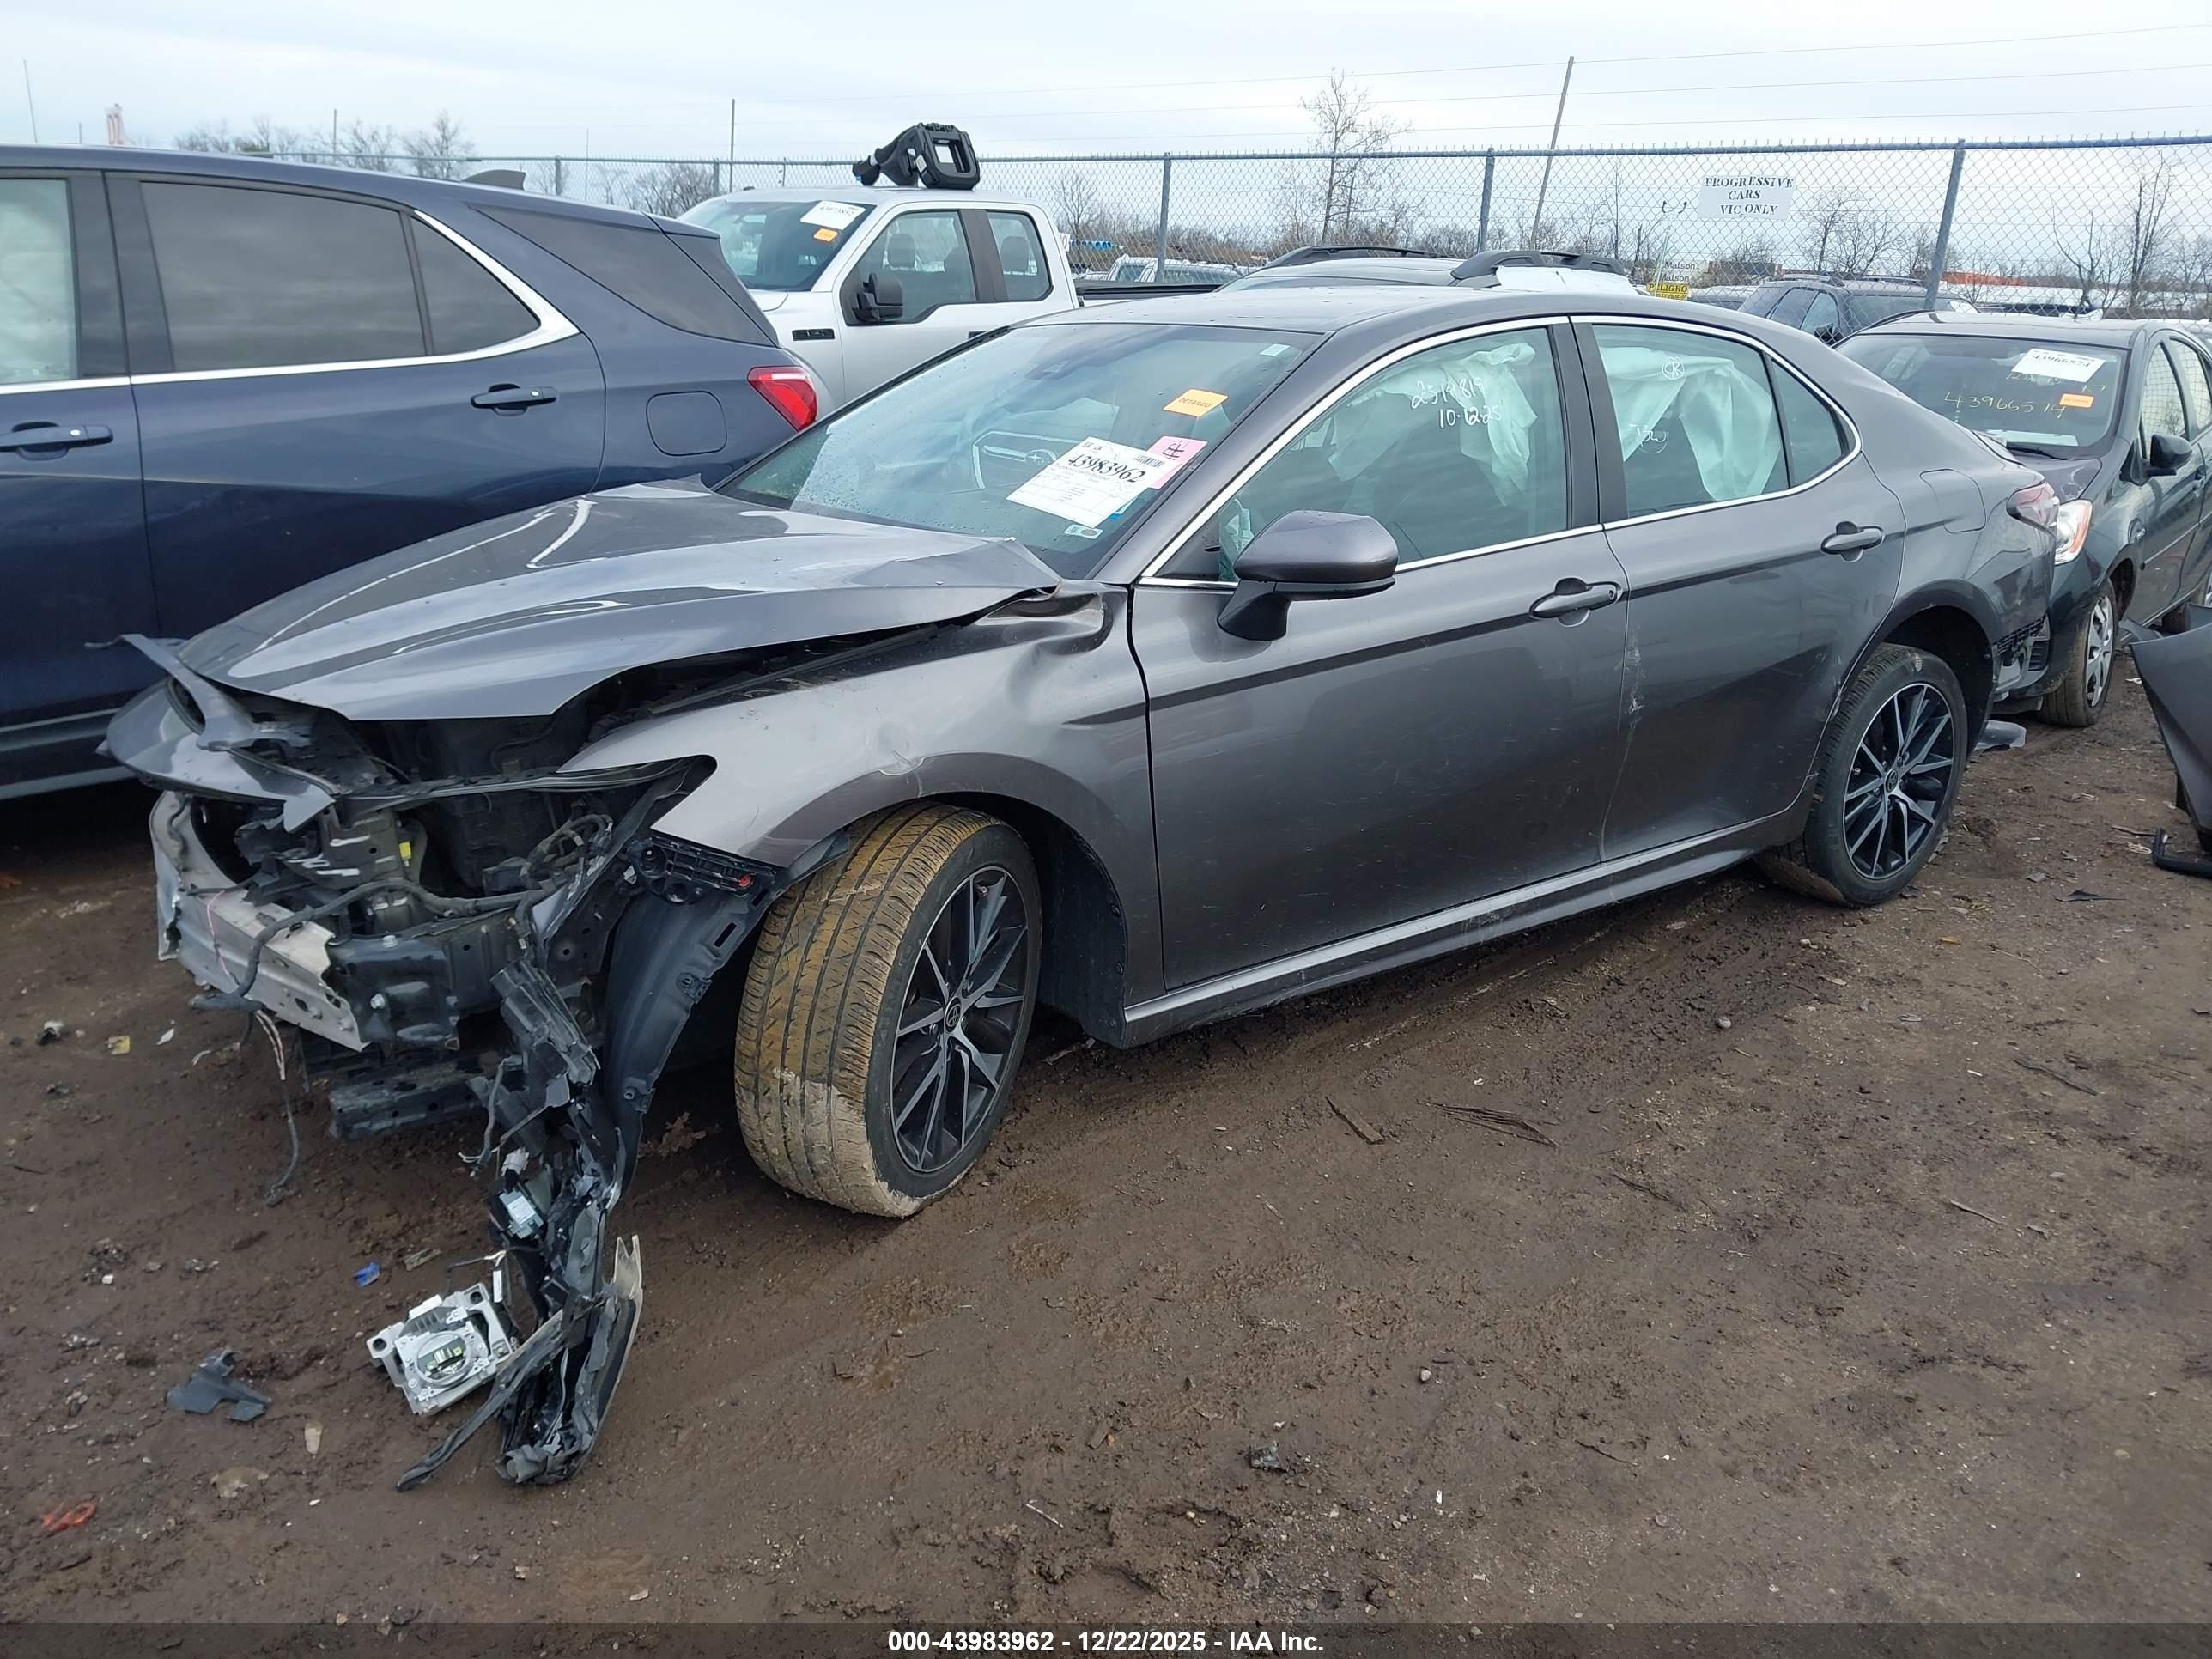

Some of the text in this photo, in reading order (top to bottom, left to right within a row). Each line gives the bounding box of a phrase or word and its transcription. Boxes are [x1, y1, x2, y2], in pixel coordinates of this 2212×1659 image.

[1705, 176, 1794, 188] PROGRESSIVE
[1728, 189, 1761, 200] CARS
[1720, 204, 1778, 215] VIC ONLY
[1665, 261, 1696, 270] Matson
[1068, 453, 1146, 483] 43983962
